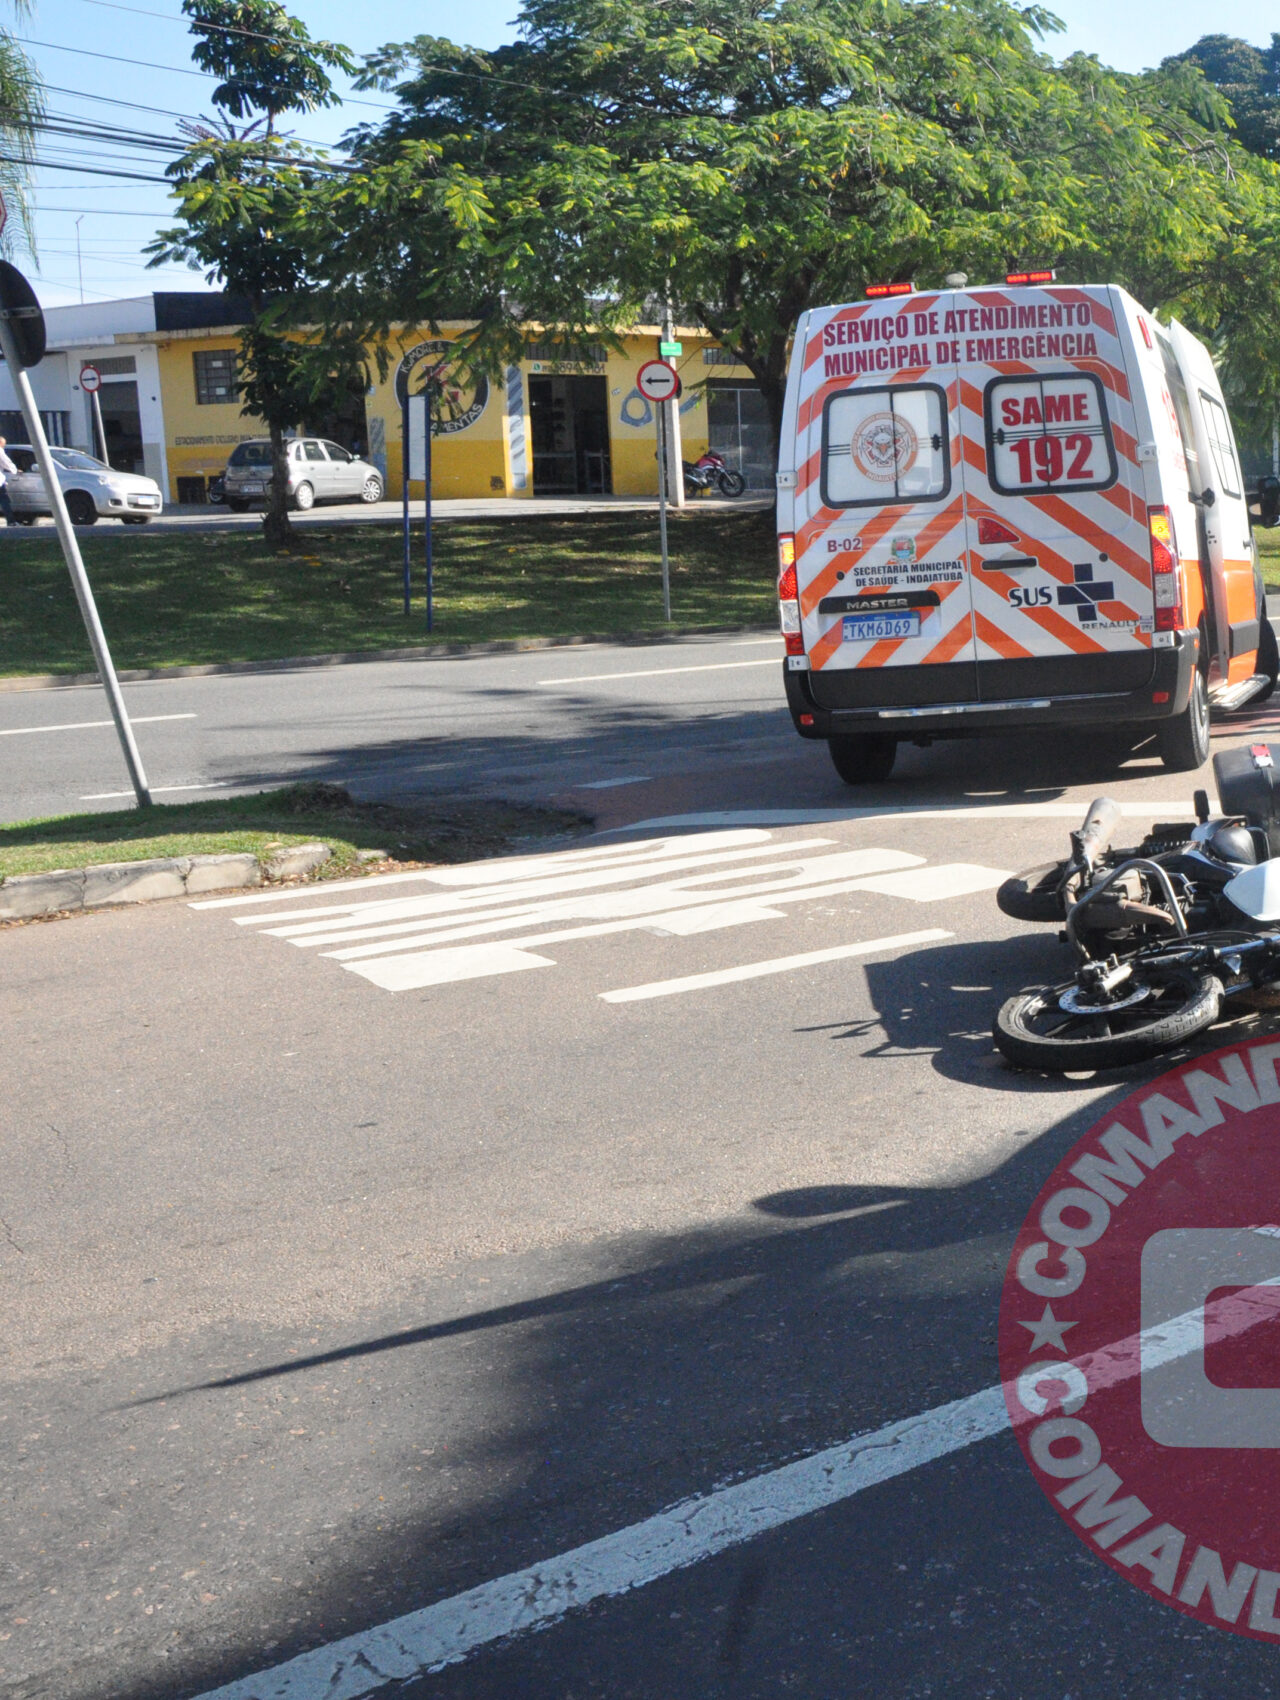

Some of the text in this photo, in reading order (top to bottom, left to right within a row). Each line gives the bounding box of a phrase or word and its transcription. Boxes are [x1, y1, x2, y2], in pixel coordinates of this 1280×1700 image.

[823, 302, 1091, 347] SERVIÇO DE ATENDIMENTO
[824, 331, 1097, 377] MUNICIPAL DE EMERGÊNCIA
[1001, 393, 1089, 426] SAME
[1009, 433, 1094, 484] 192
[827, 537, 862, 553] B-02
[853, 560, 962, 576] SECRETARIA MUNICIPAL
[856, 577, 867, 587] DE
[906, 572, 963, 584] INDAIATUBA
[846, 598, 909, 610] MASTER
[1009, 586, 1053, 607] SUS
[850, 619, 911, 638] TKM6D69
[1082, 620, 1137, 630] RENAULT
